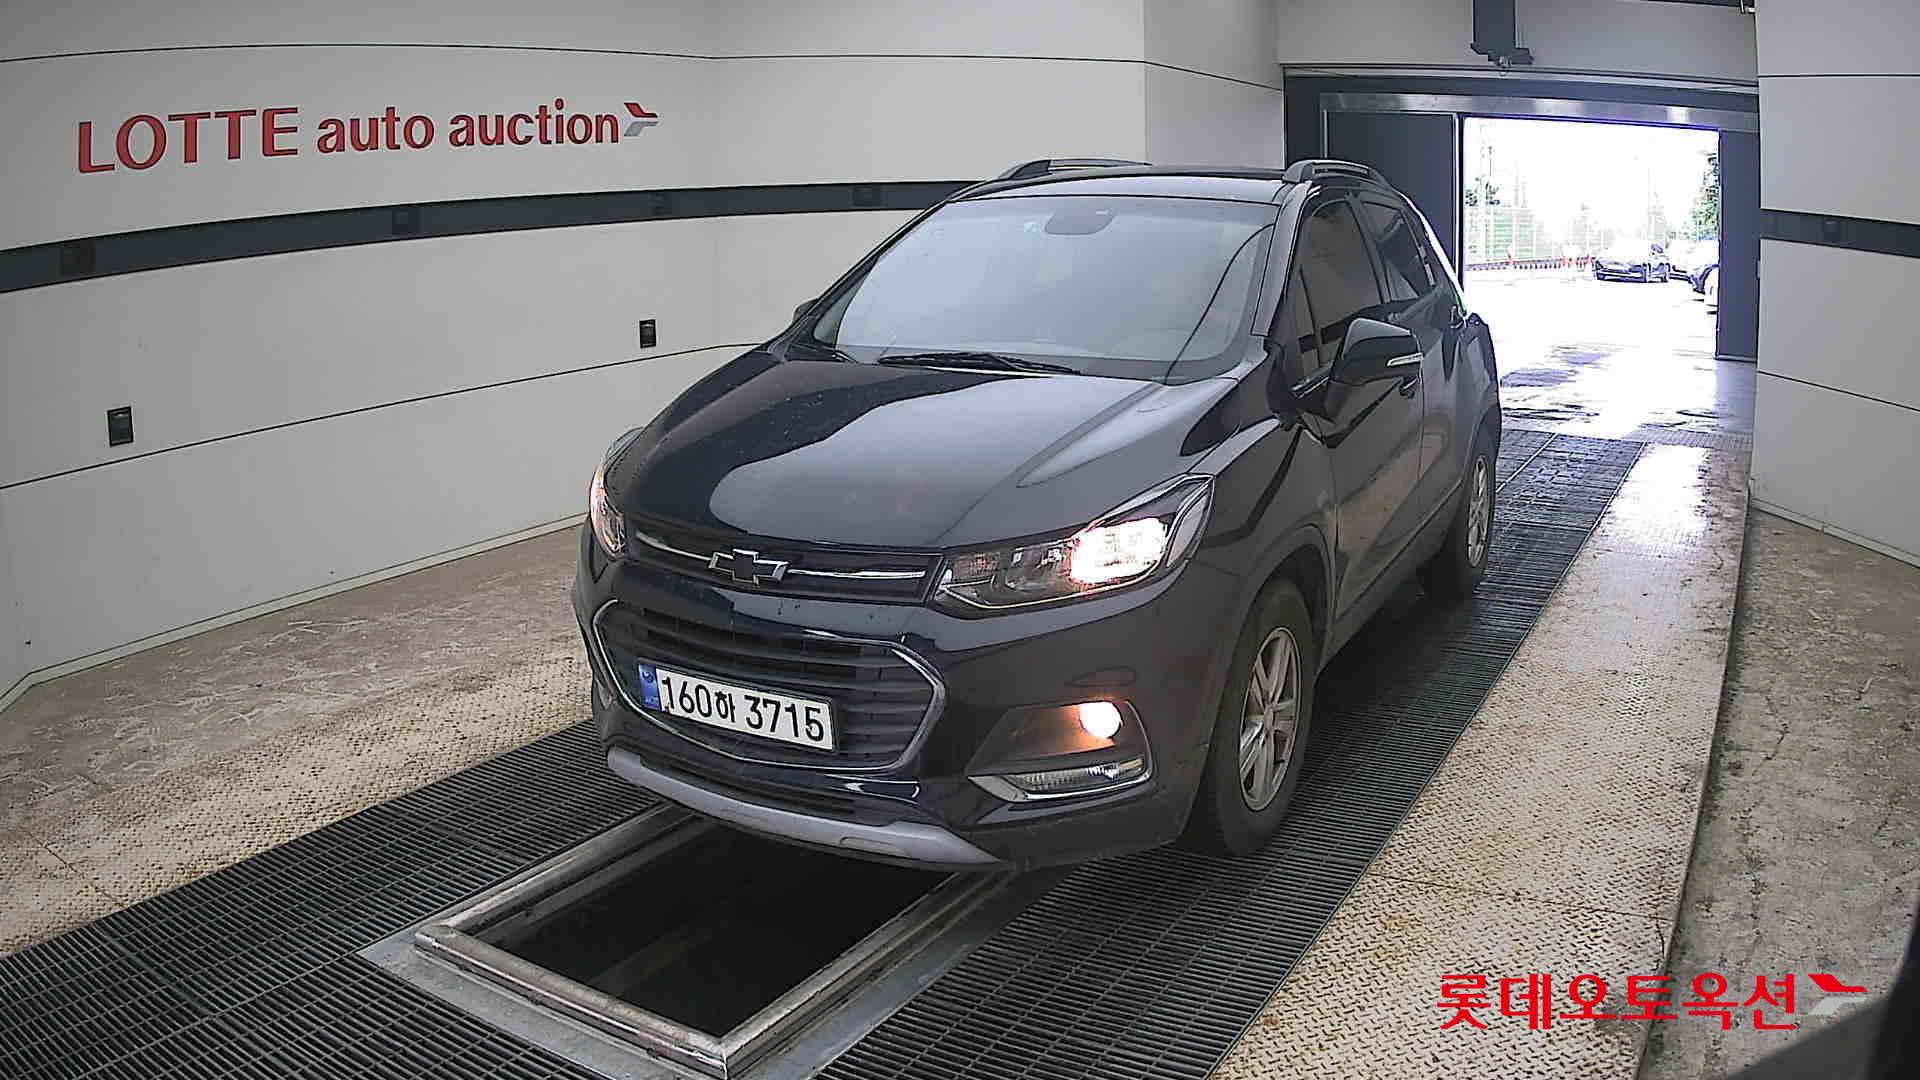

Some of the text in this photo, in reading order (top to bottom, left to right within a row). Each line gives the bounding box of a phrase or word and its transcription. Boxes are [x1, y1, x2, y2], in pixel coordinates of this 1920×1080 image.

[78, 98, 621, 174] LOTTE auto auction
[661, 675, 825, 742] 160하 3715
